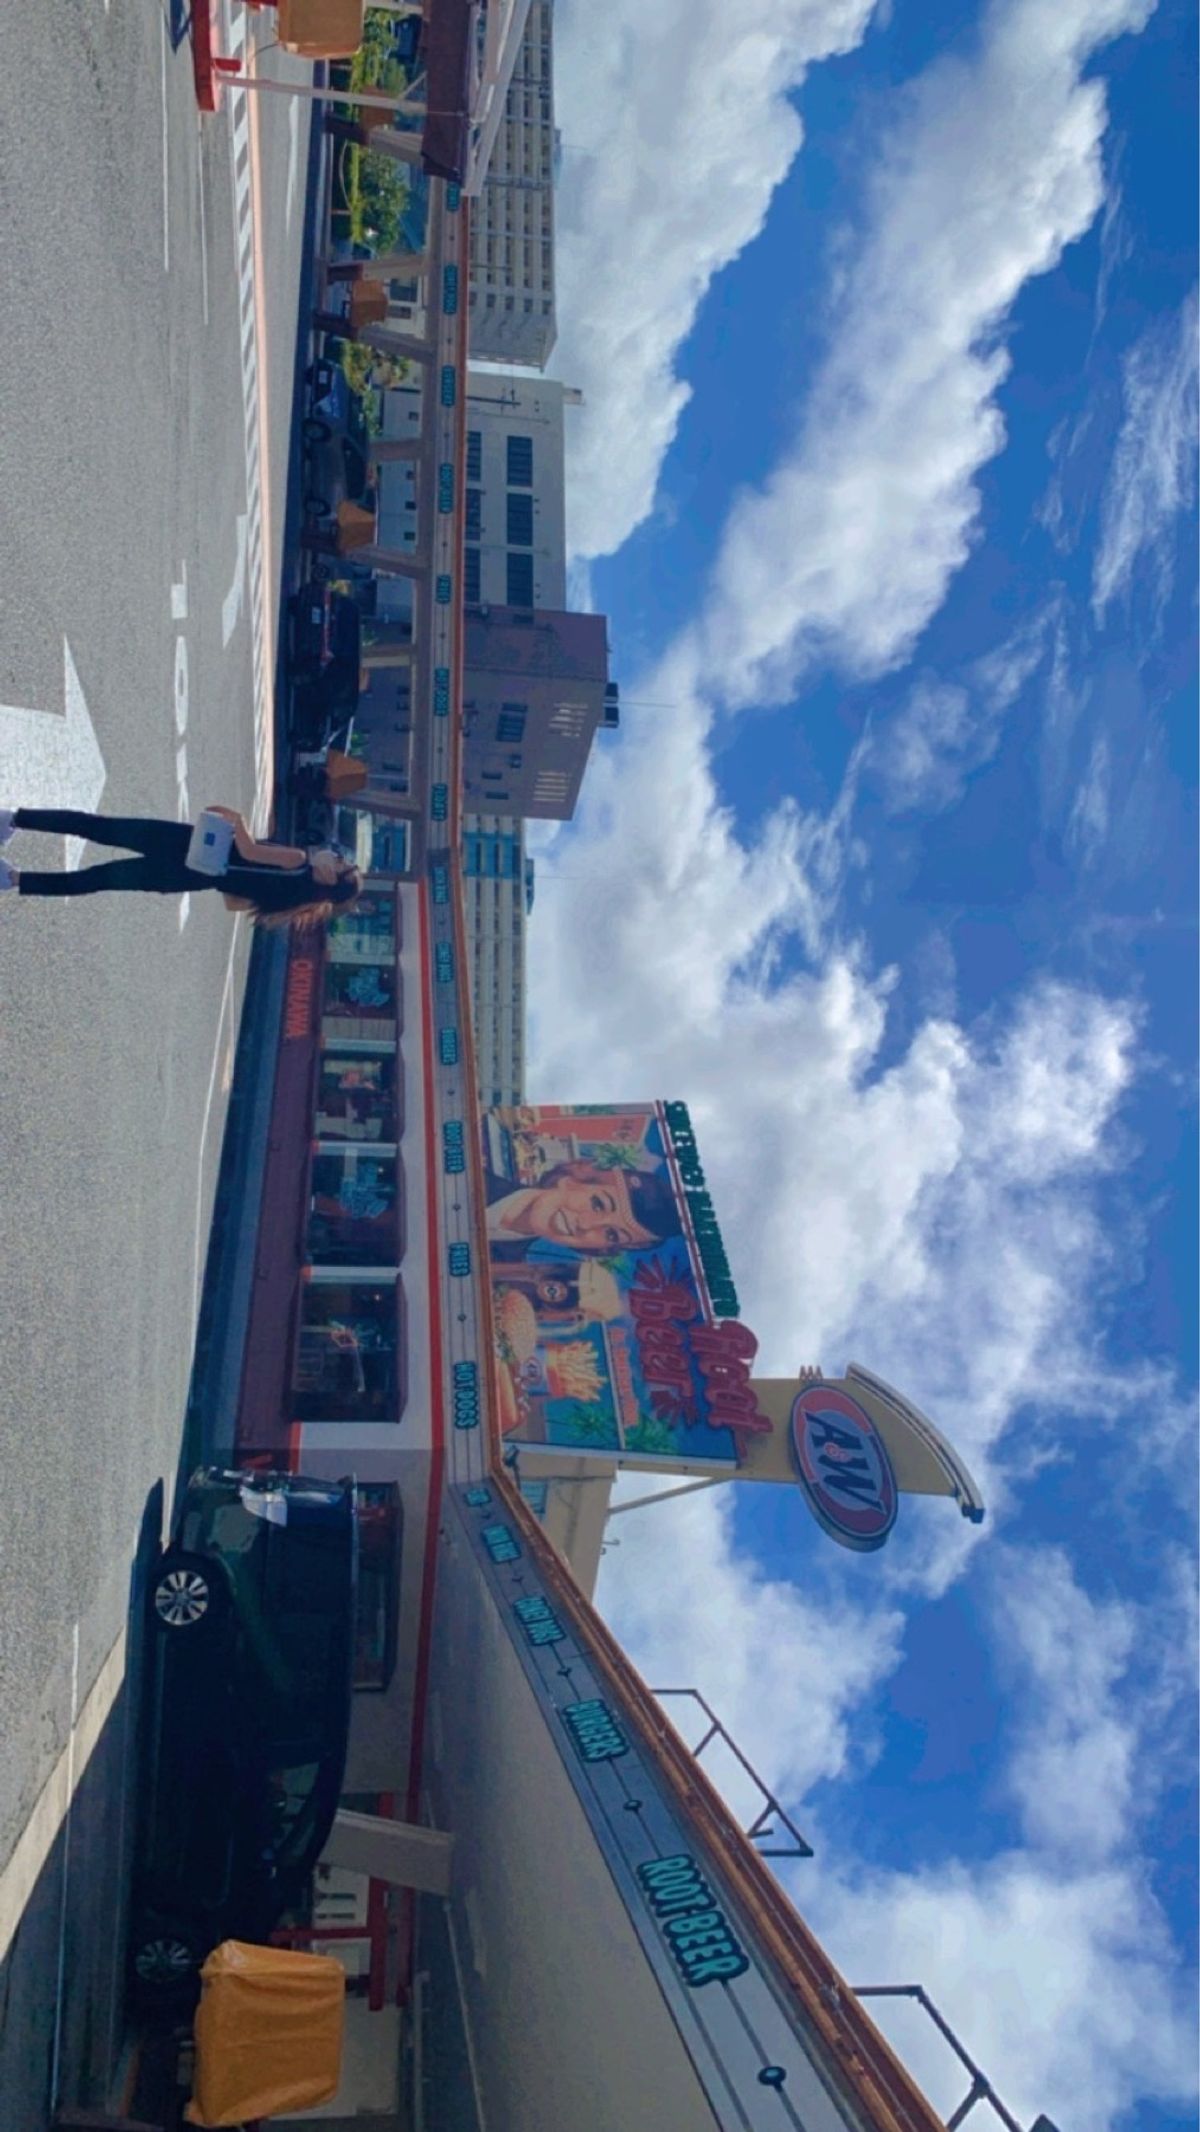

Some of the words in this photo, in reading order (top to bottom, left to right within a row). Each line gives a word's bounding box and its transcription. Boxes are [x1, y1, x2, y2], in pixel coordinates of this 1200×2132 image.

[436, 575, 450, 603] FRIES
[435, 668, 449, 687] HOT
[433, 784, 447, 821] FLOATS
[286, 959, 313, 1039] OKINAWA
[449, 1243, 470, 1277] FRIES
[629, 1285, 697, 1396] Beer
[453, 1361, 477, 1390] HOT
[455, 1390, 479, 1429] DOGS
[803, 1409, 887, 1515] A&W
[564, 1700, 629, 1762] BURGERS
[637, 1856, 715, 1914] ROOT
[666, 1912, 747, 1983] BEER
